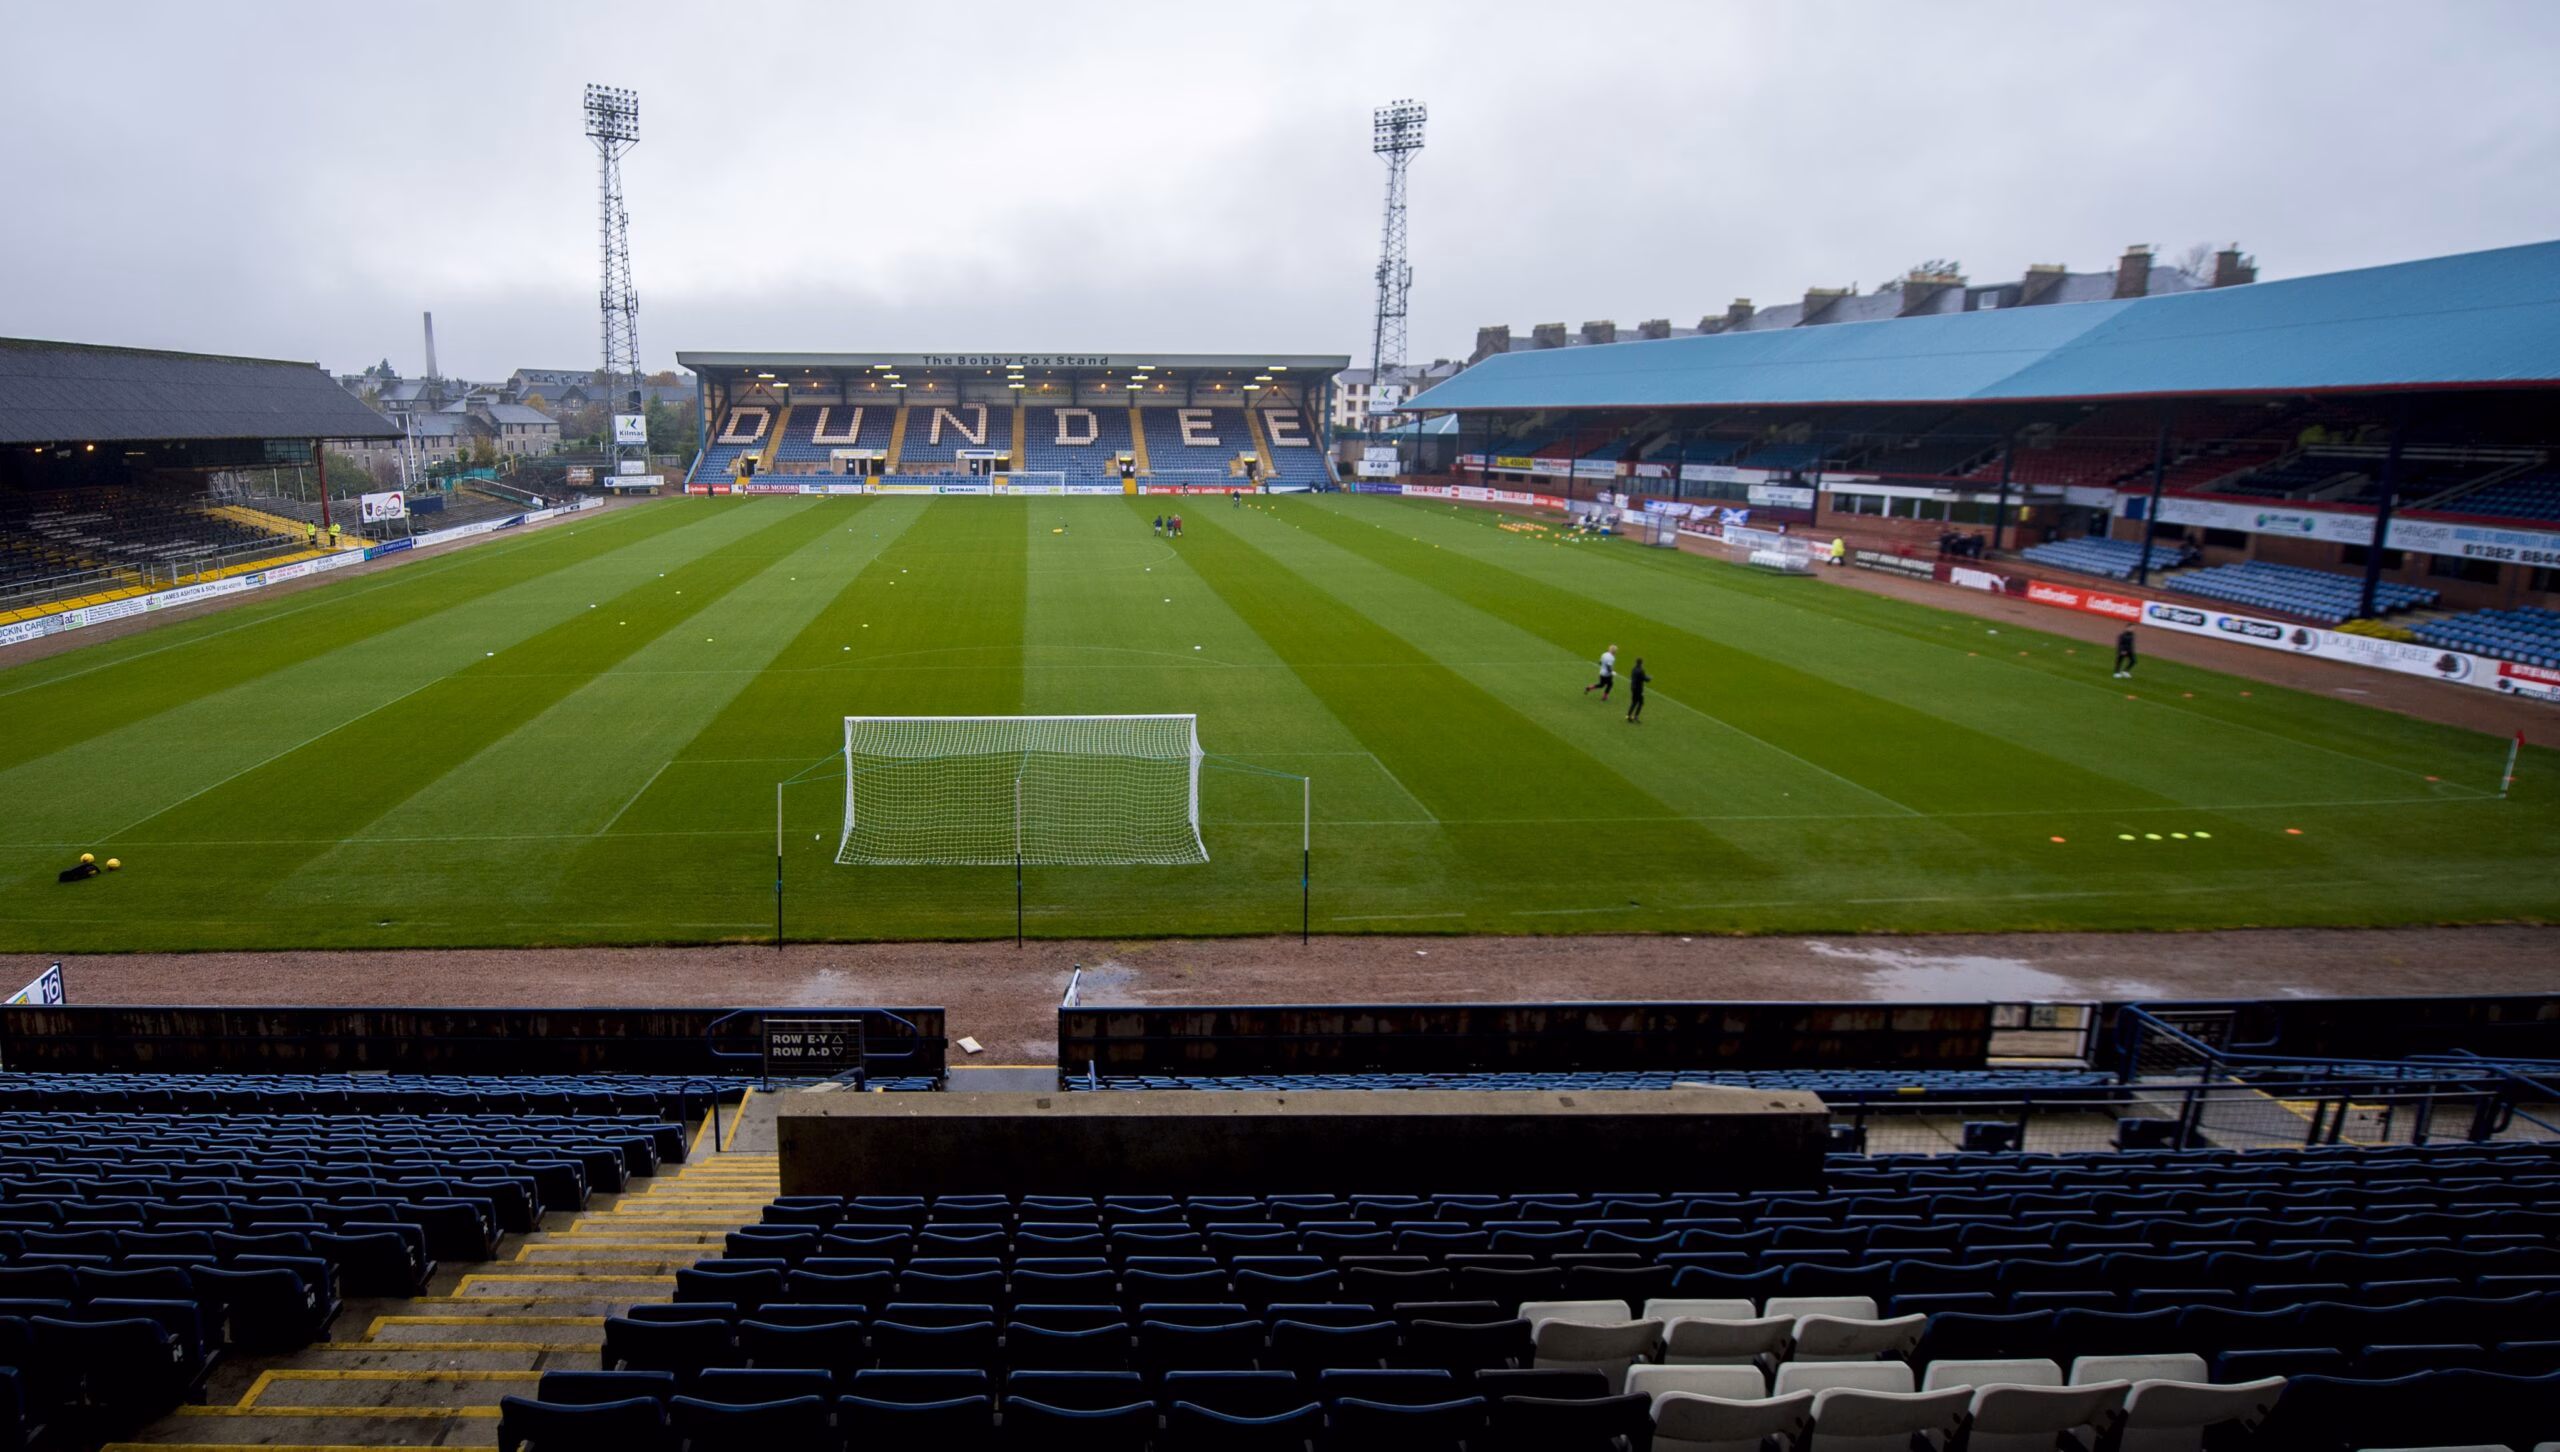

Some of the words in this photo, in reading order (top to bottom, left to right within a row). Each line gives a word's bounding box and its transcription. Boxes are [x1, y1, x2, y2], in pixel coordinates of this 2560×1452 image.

[923, 356, 953, 366] The
[958, 356, 1013, 366] Bobby
[1020, 356, 1050, 366] Cox
[1056, 355, 1109, 366] Stand
[163, 593, 179, 601] JAMES
[180, 589, 200, 597] ASHTON
[2243, 621, 2279, 638] Sport
[42, 973, 59, 1003] 16
[772, 1034, 802, 1044] ROW
[807, 1034, 828, 1044] E-Y
[772, 1047, 802, 1056] ROW
[807, 1047, 830, 1056] A-D
